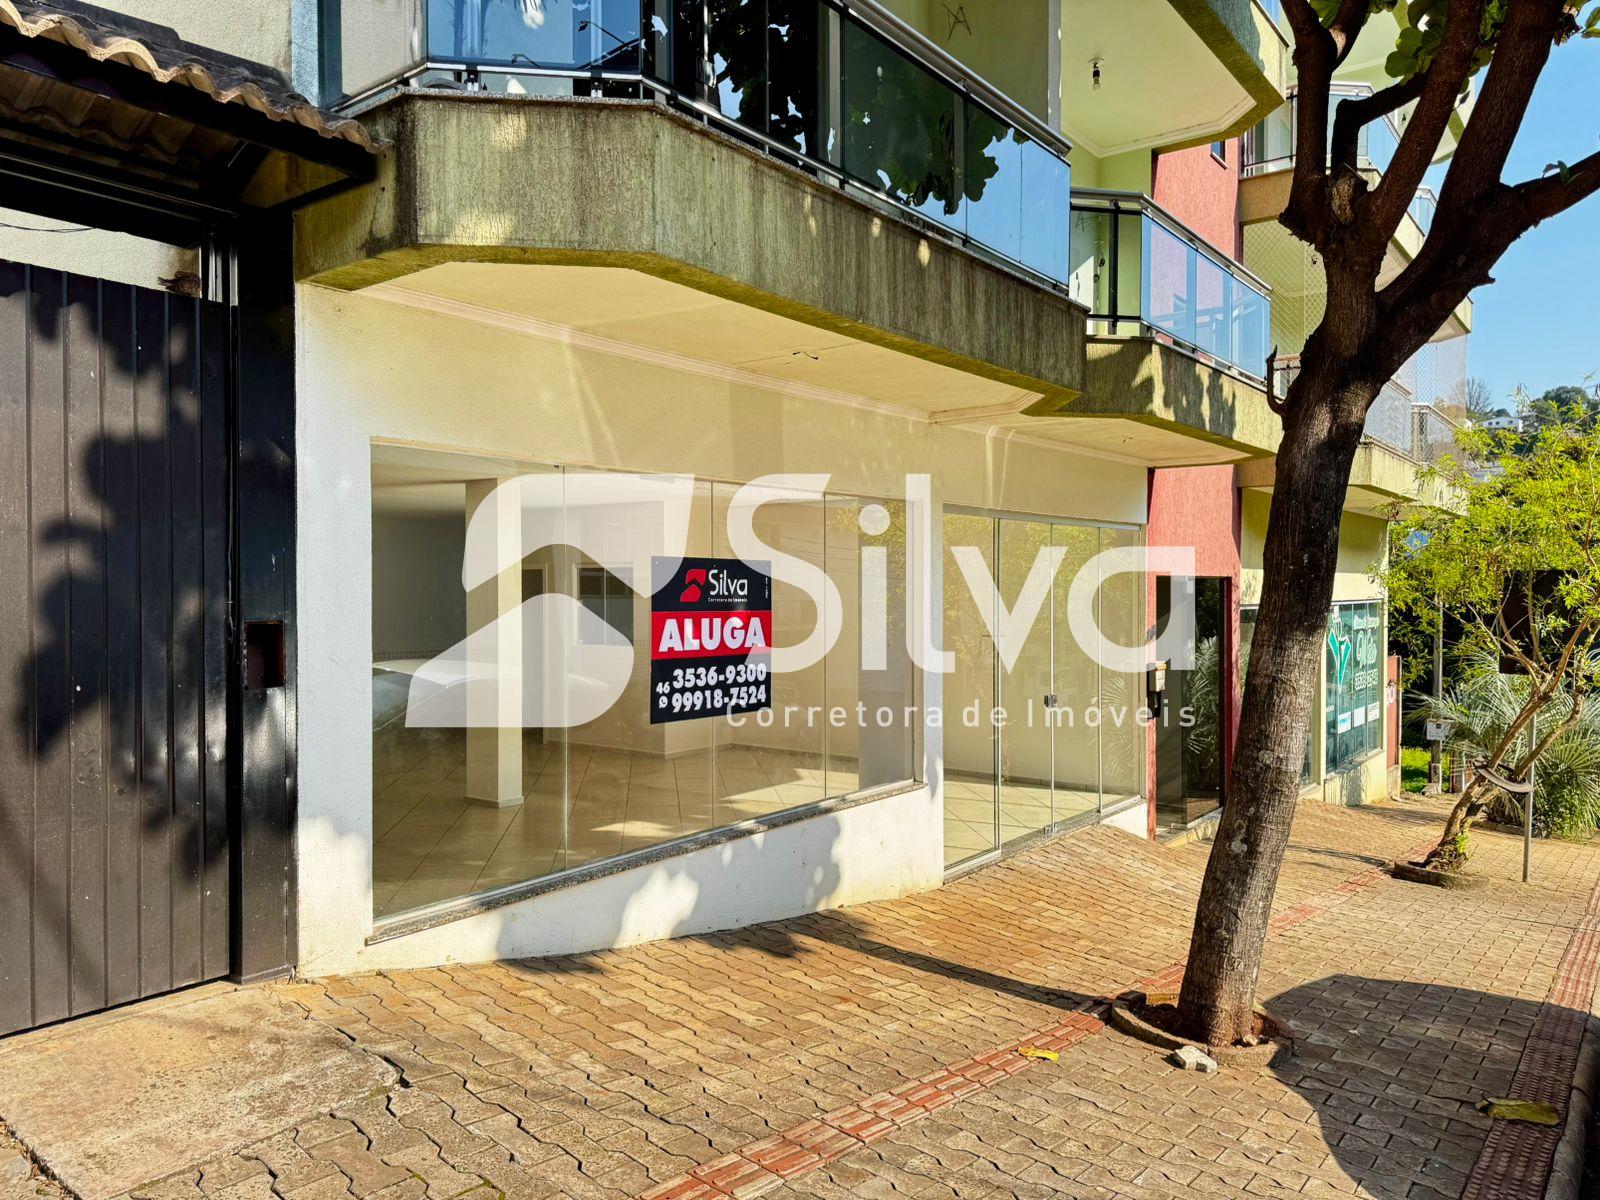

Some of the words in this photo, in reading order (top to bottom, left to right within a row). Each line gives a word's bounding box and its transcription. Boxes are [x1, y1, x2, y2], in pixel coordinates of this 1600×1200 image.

[708, 569, 748, 596] Silva
[658, 617, 767, 652] ALUGA
[656, 682, 671, 695] 46
[672, 663, 767, 689] 3536-9300
[671, 684, 767, 713] 99918-7524
